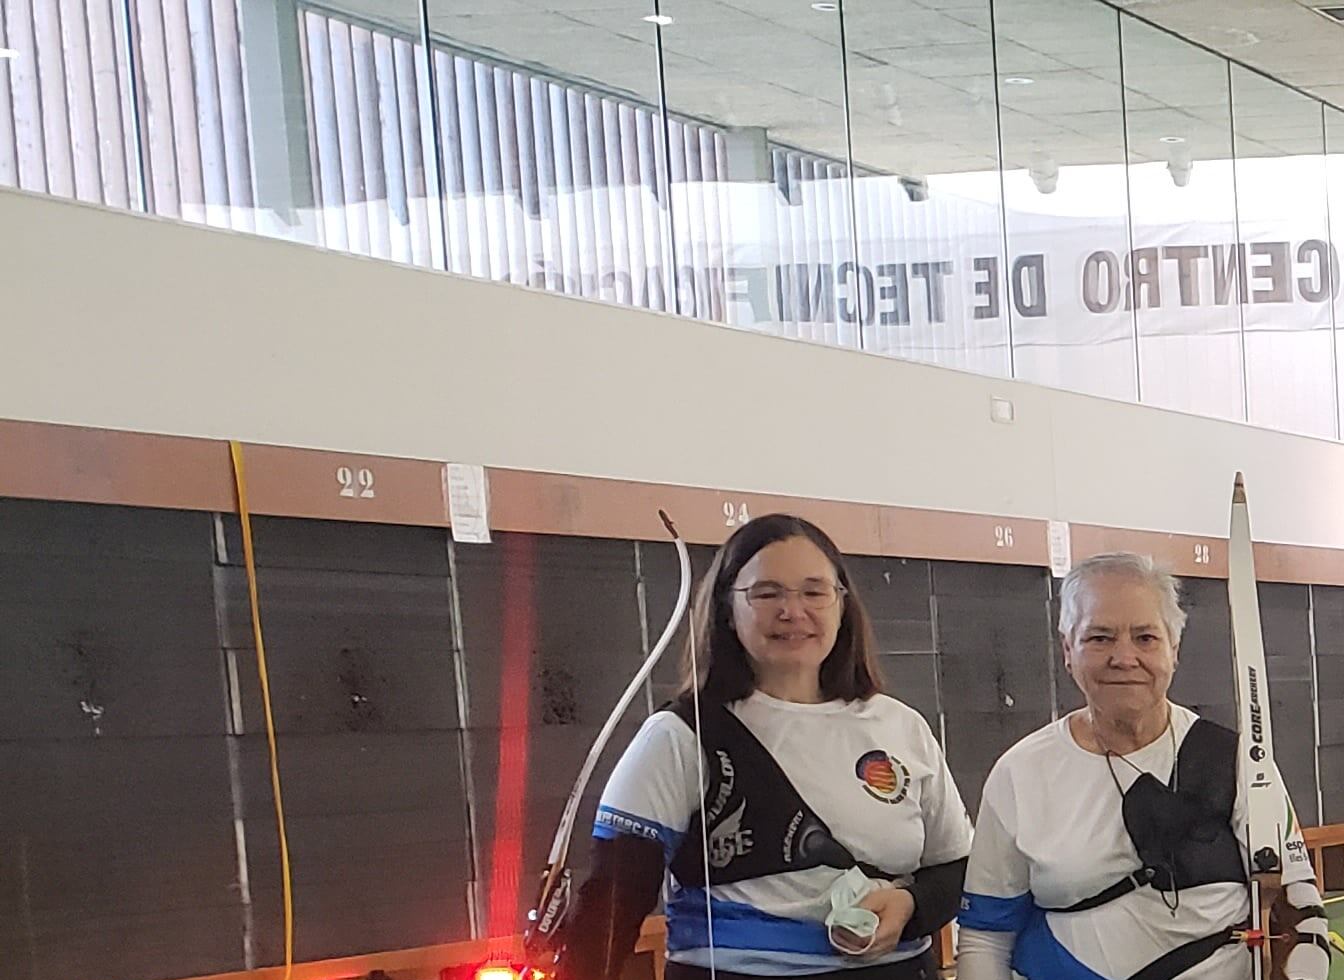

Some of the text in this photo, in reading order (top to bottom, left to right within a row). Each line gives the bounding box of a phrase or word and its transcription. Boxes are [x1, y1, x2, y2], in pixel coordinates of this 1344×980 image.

[336, 467, 375, 498] 22
[723, 502, 750, 526] 24
[995, 526, 1013, 547] 26
[1195, 544, 1209, 564] 28
[1251, 704, 1264, 743] CORE
